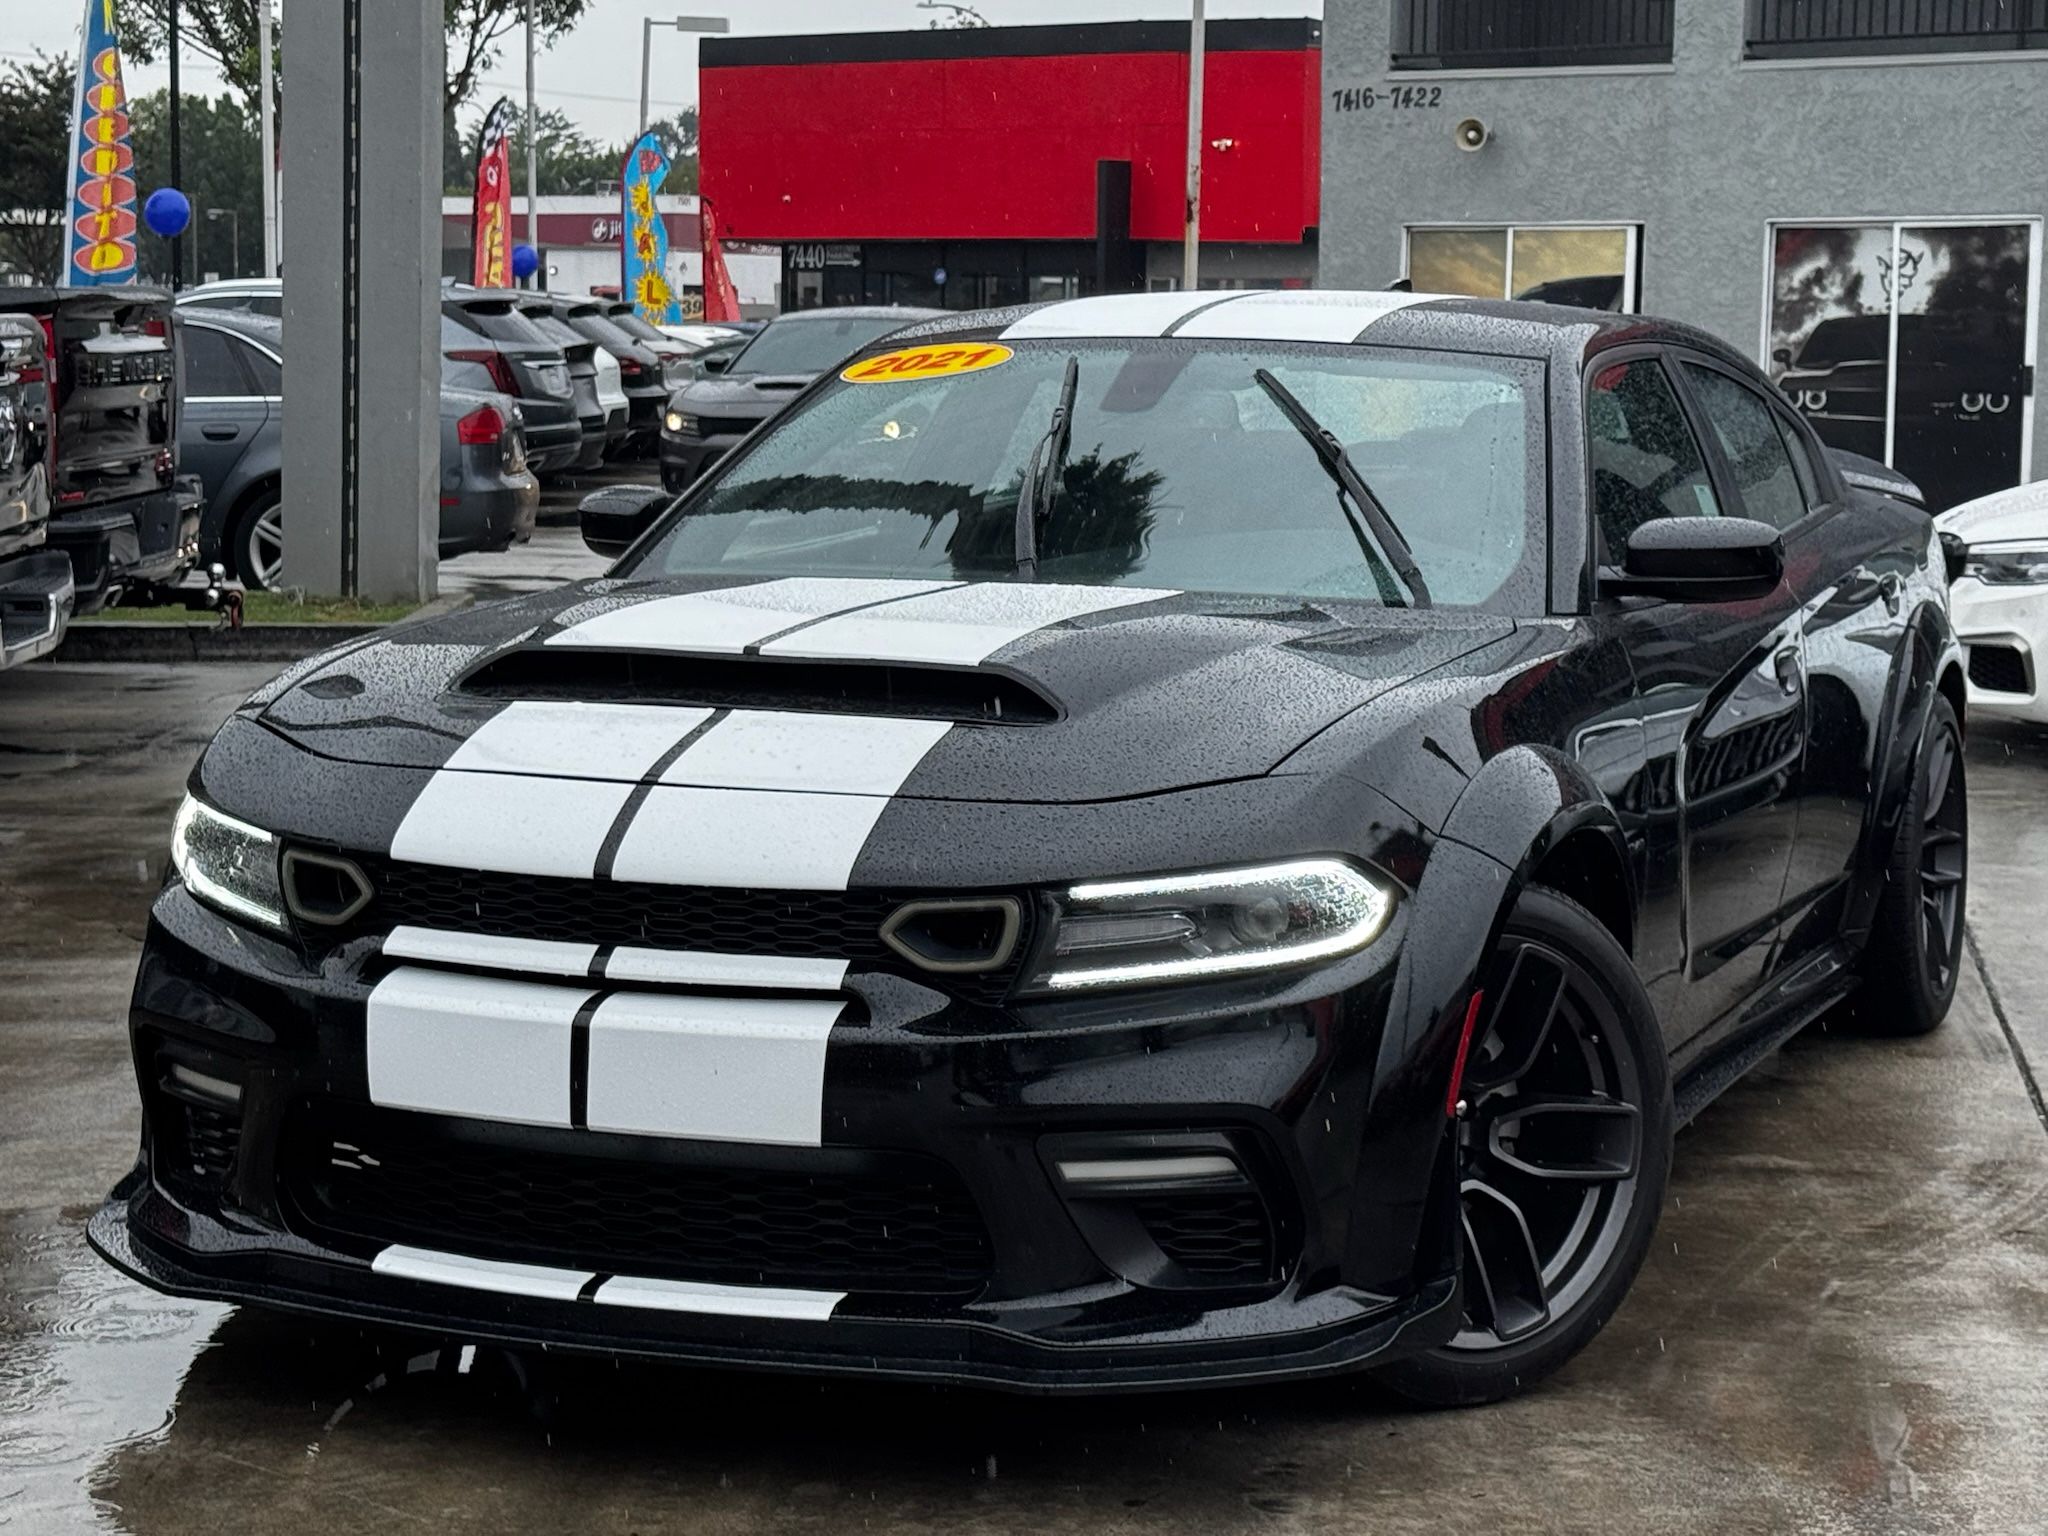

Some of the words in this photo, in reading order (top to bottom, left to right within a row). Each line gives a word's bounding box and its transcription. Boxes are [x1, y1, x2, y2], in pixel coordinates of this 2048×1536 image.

[1332, 86, 1442, 112] 7416-7422
[788, 244, 825, 269] 7440
[852, 349, 997, 378] 2021
